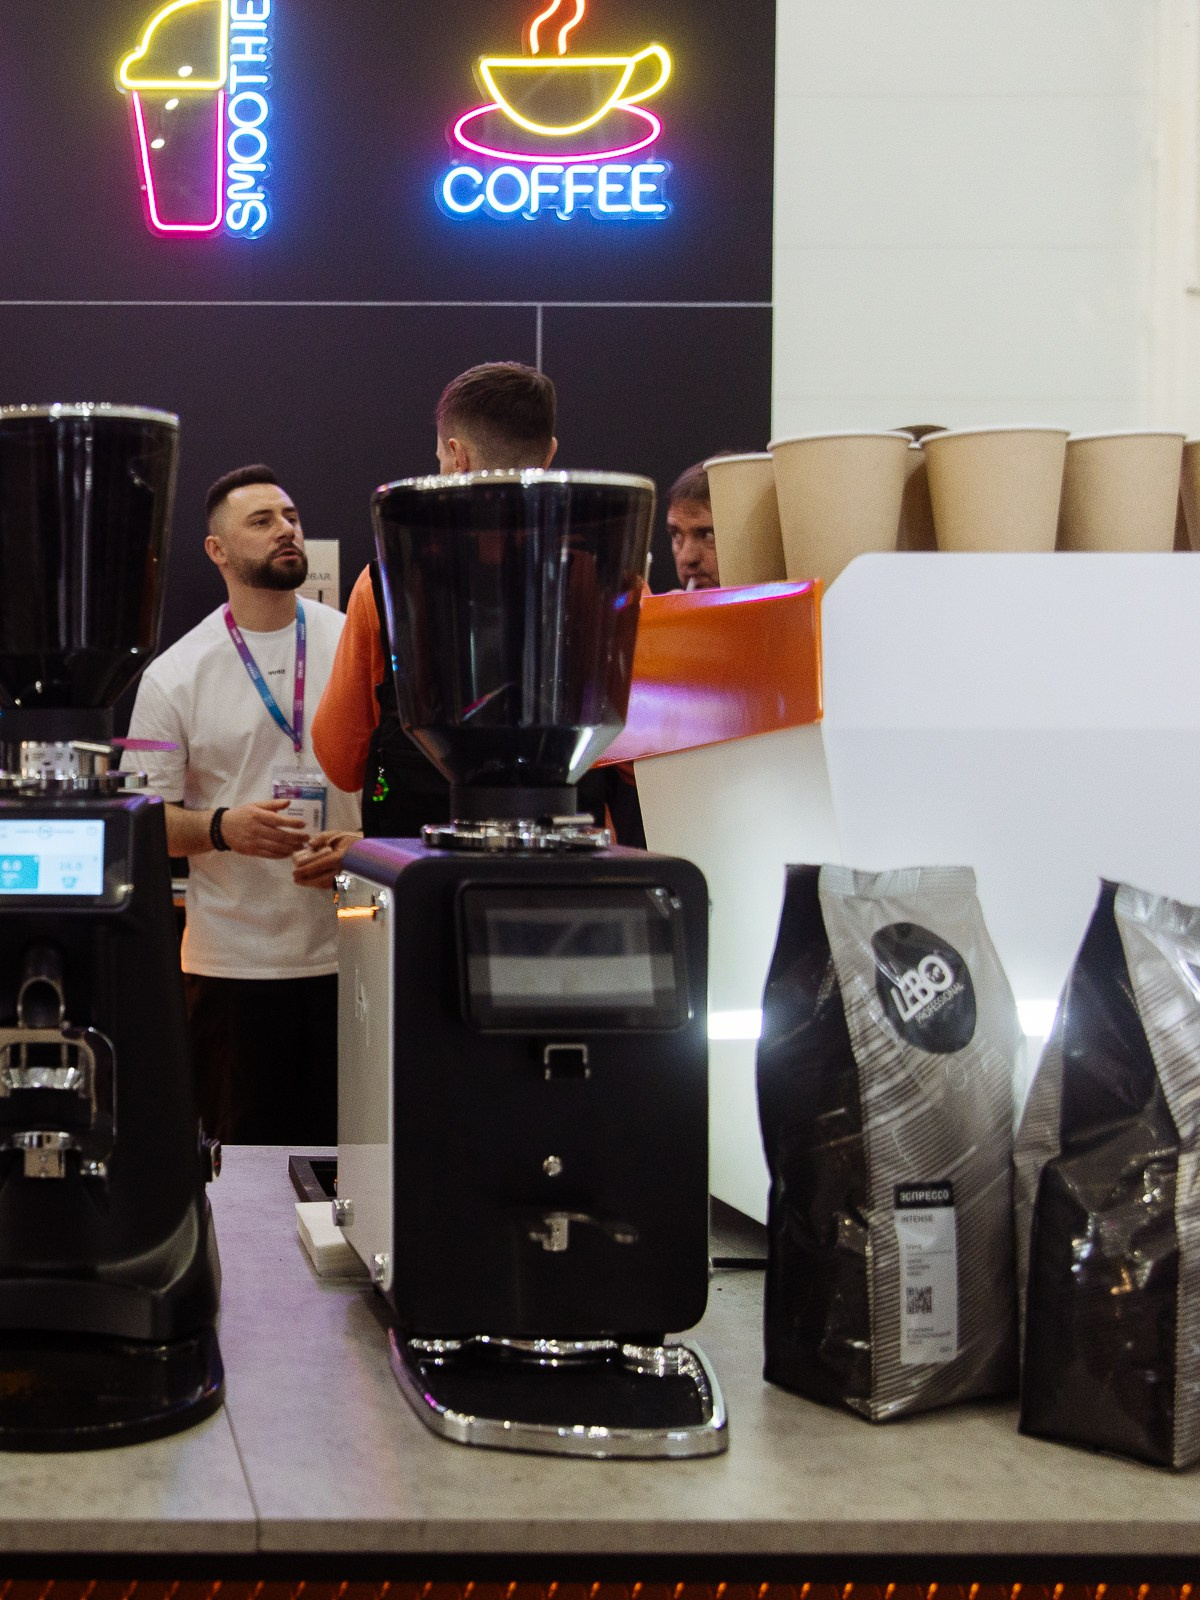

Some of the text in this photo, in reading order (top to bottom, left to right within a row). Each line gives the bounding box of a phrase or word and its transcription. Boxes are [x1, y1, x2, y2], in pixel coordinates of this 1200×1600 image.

[227, 0, 271, 233] SMOOTHIE
[442, 164, 667, 213] COFFEE
[890, 954, 954, 1022] LEBO
[915, 981, 965, 1024] PROFESSIONAL
[900, 1189, 950, 1202] ЭСПРЕССО
